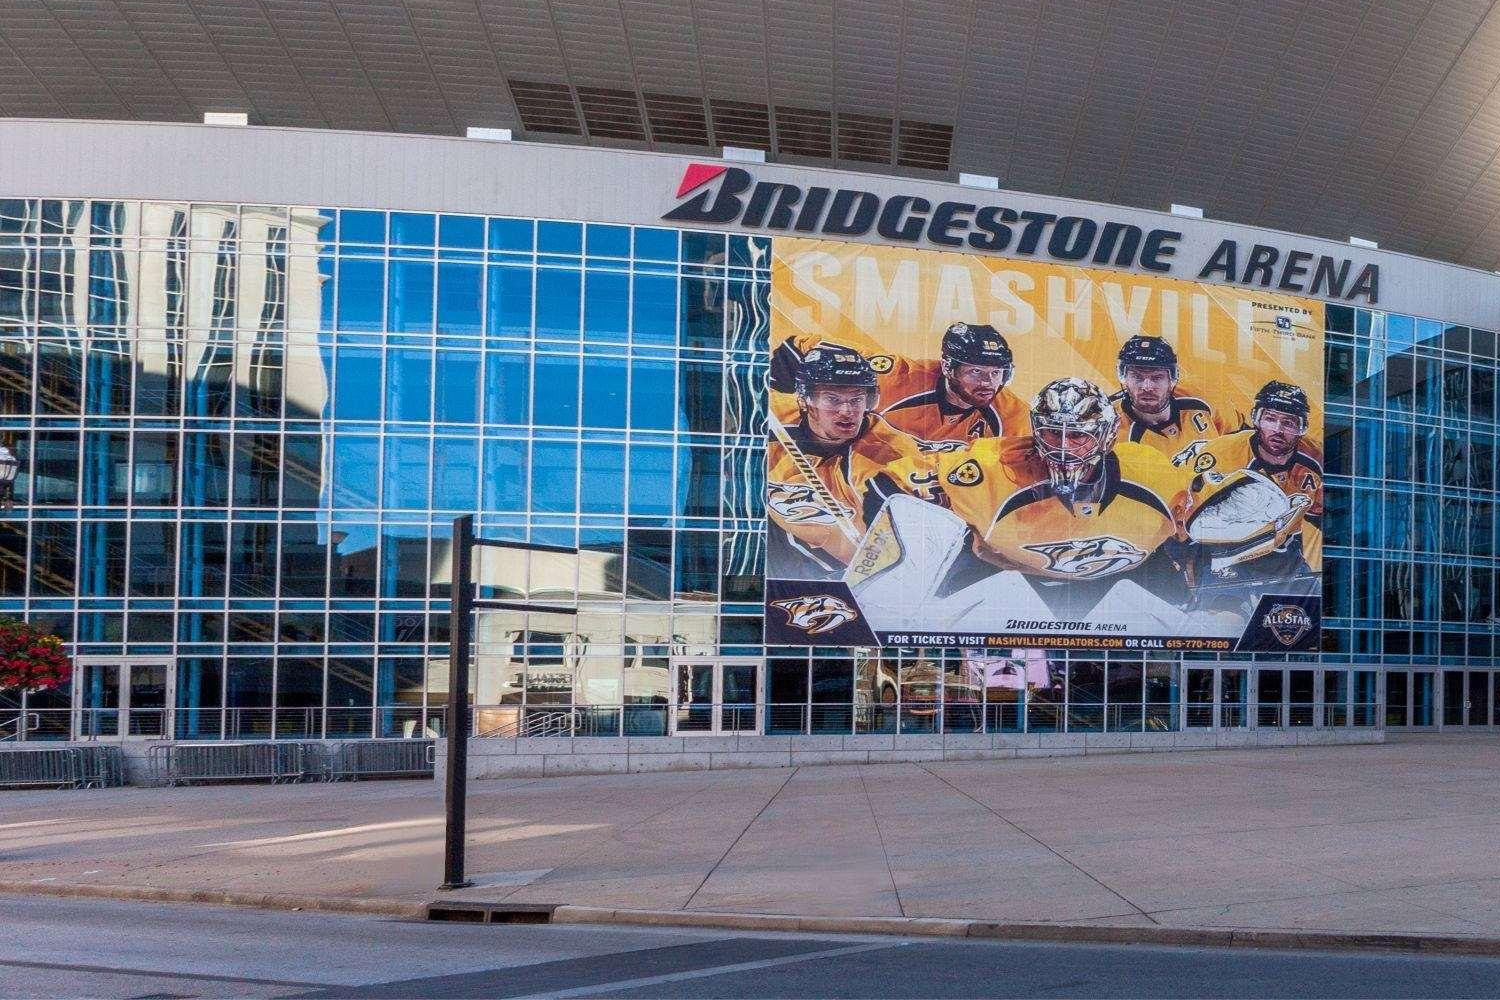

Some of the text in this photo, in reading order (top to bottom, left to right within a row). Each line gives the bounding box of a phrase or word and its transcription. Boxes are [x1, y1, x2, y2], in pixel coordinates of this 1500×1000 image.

[661, 163, 1381, 304] BRIDGESTONE ARENA
[1251, 301, 1300, 315] PRESENTED
[788, 251, 1311, 384] SMASHVILLE
[1301, 472, 1318, 491] A
[1006, 619, 1128, 632] BRIDGESTONE ARENA
[887, 635, 909, 645] FOR
[912, 635, 956, 645] TICKETS
[958, 636, 986, 645] VISIT
[988, 636, 1123, 648] NASHVILLEPREDATORS.COM
[1125, 639, 1142, 648] OR
[1145, 639, 1164, 648] CALL
